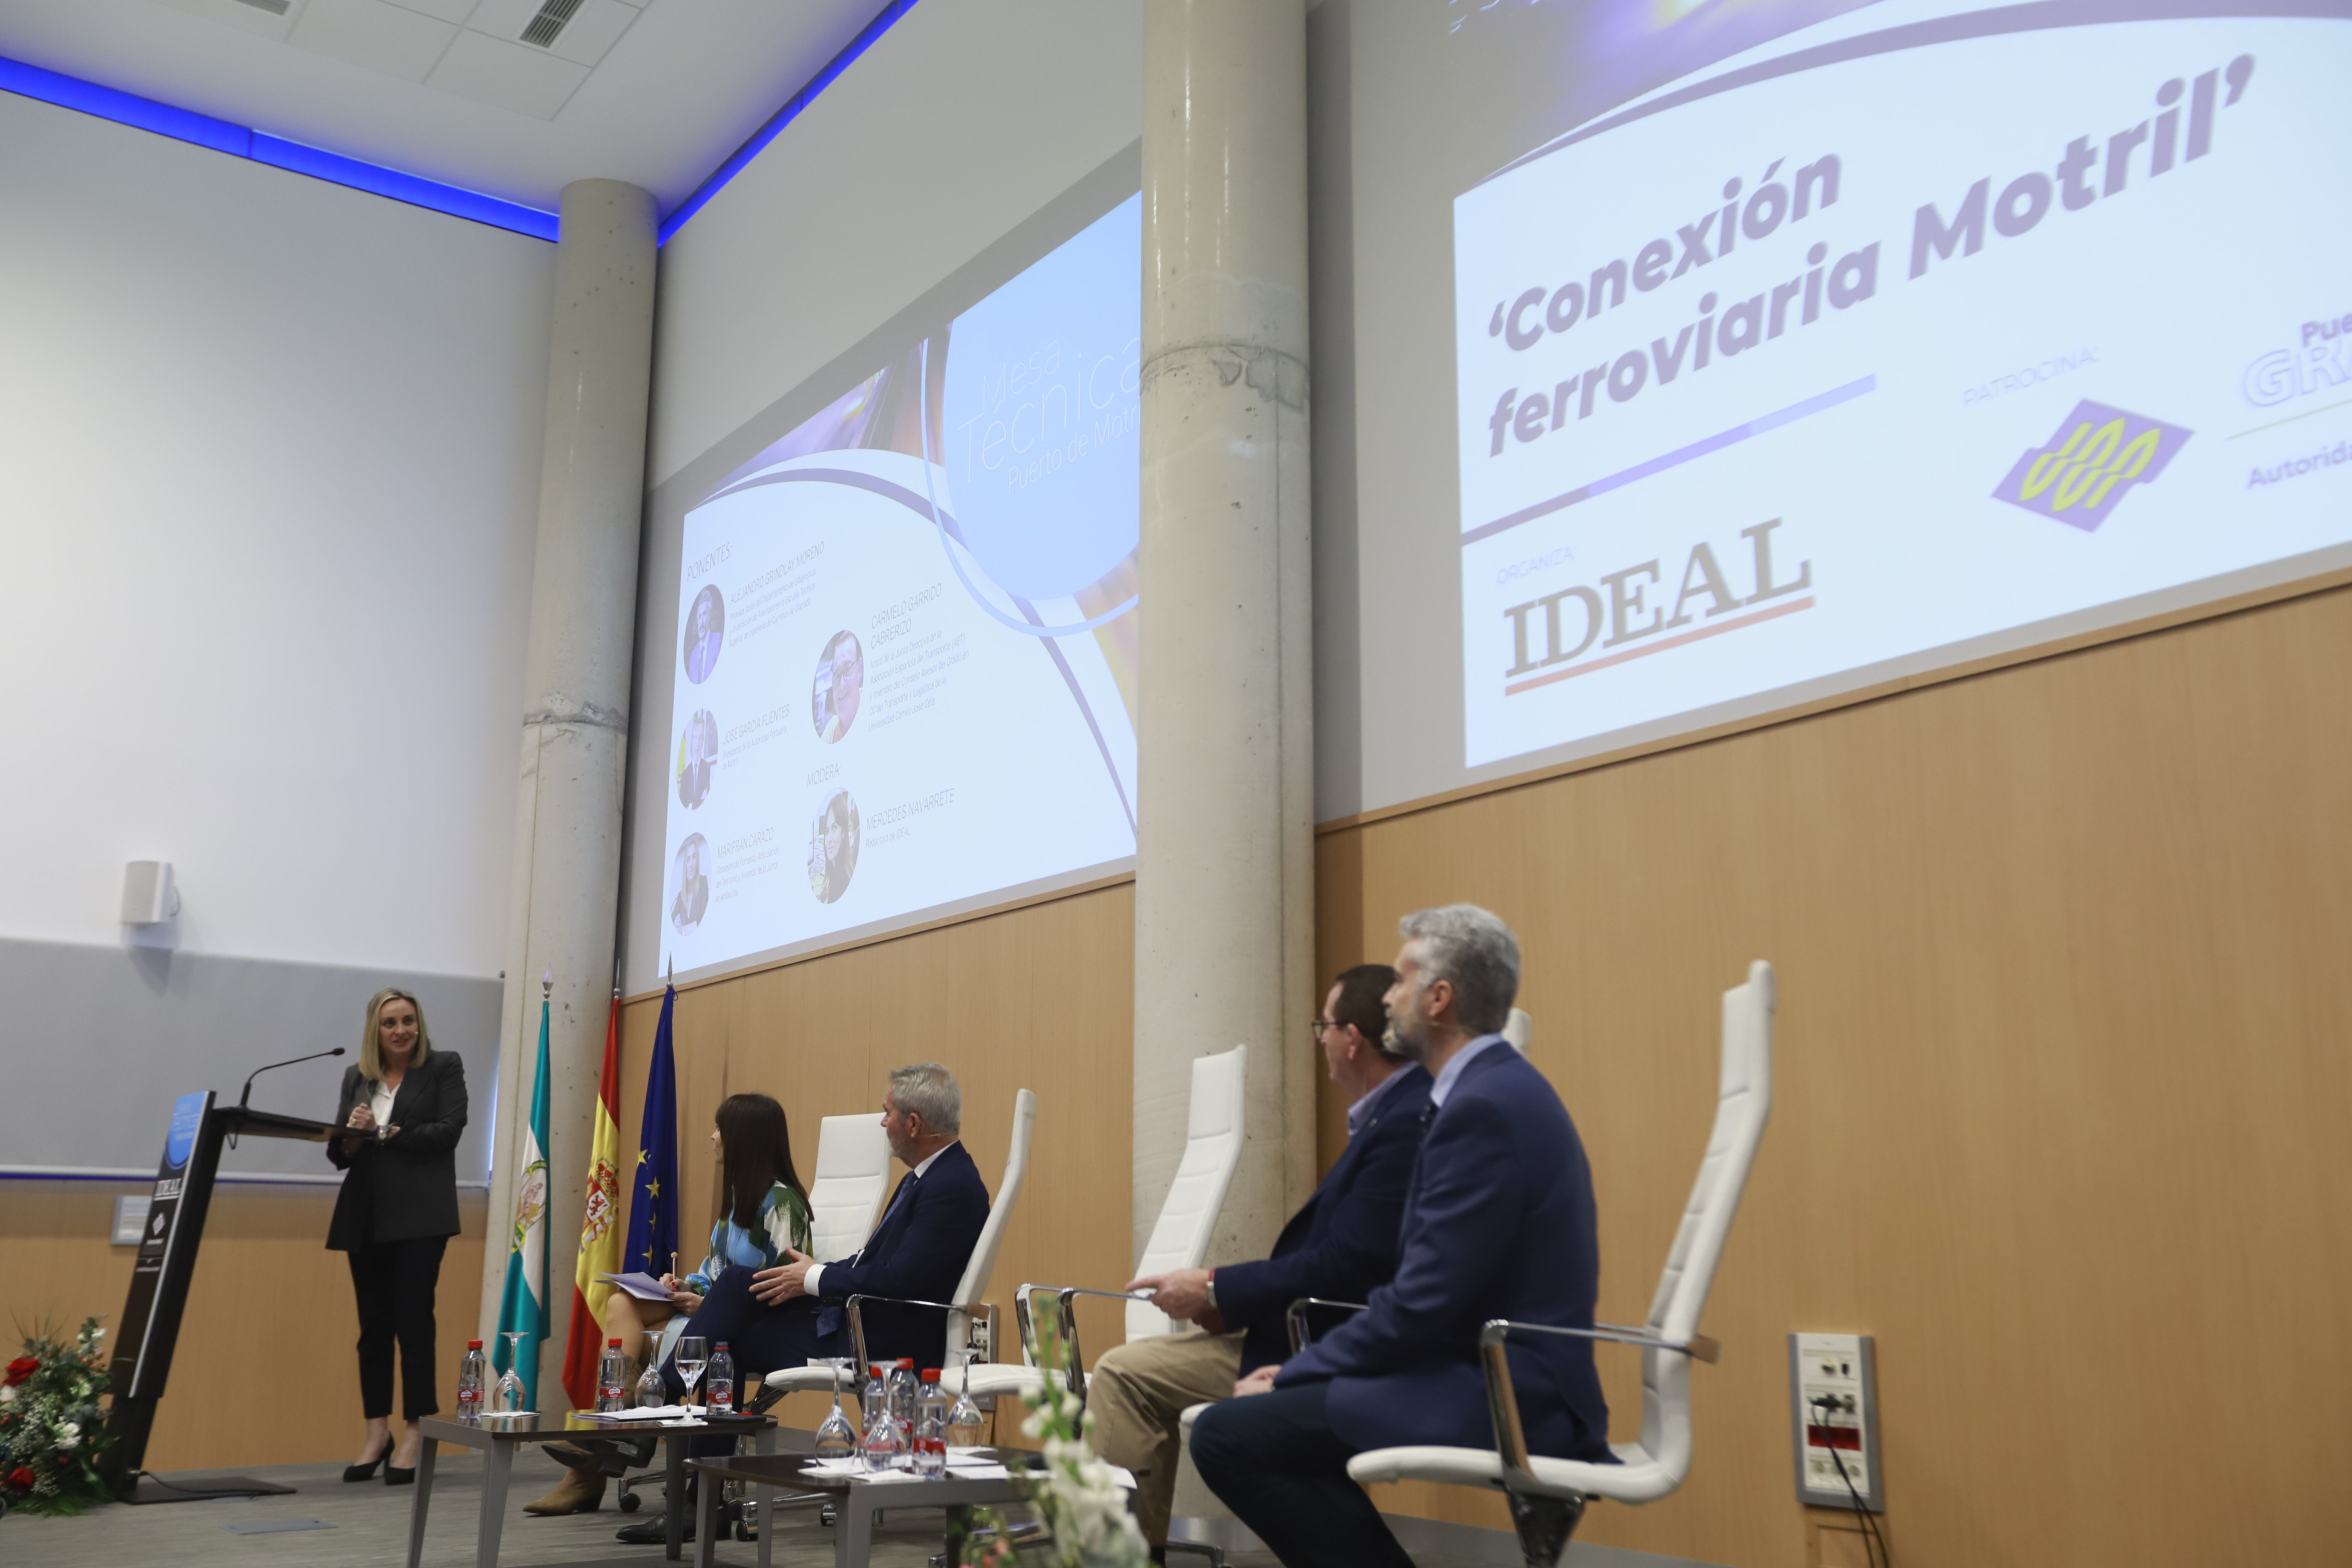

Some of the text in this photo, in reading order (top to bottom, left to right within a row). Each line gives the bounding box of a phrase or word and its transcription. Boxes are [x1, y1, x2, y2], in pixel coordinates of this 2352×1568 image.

[1488, 240, 1882, 458] ferroviaria
[983, 340, 1060, 414] Mesa
[1962, 346, 2099, 408] PATROCINA:
[2243, 337, 2352, 407] GR
[1009, 403, 1140, 495] Puerto de Motri
[2248, 439, 2352, 489] Autorid
[687, 541, 732, 582] PONENTES:
[730, 541, 824, 605] ALEJANDRO GRINDLAY MORENO
[1498, 547, 1576, 583] ORGANIZA:
[730, 608, 744, 621] Profesor
[745, 601, 755, 613] titular
[762, 583, 789, 603] Departamento
[789, 580, 794, 588] de
[732, 616, 752, 632] Ordenación
[758, 604, 775, 618] Territorio
[785, 590, 799, 605] Escuela
[872, 583, 942, 629] CARMELO GARRIDO
[1504, 517, 1811, 678] IDEAL
[729, 634, 743, 648] Superior
[744, 631, 748, 640] de
[767, 618, 772, 627] de
[772, 610, 789, 625] Caminos
[789, 606, 795, 615] de
[795, 597, 811, 612] Granada
[871, 618, 911, 649] CABRERIZO
[870, 667, 894, 684] Asociación
[895, 657, 916, 674] Española
[925, 642, 951, 659] Transporte
[952, 633, 965, 650] (AET)
[871, 629, 941, 669] Vocal de la Junta Directiva de la
[873, 684, 893, 698] miembro
[902, 671, 920, 686] Consejo
[921, 664, 937, 678] Asesor
[947, 652, 962, 666] Grado
[963, 650, 969, 660] en
[868, 712, 894, 731] Universidad
[895, 707, 911, 721] Camilo
[925, 697, 935, 708] Cela
[869, 705, 876, 716] CC
[884, 693, 908, 710] Transporte
[909, 691, 912, 701] y
[913, 681, 934, 697] Logística
[935, 678, 941, 688] de
[942, 675, 946, 684] la
[723, 704, 790, 744] JOSÉ GARCÍA FUENTES
[723, 725, 787, 759] Presidente de la Autoridad Portuaria
[723, 762, 727, 770] de
[807, 763, 841, 787] MODERA:
[867, 787, 954, 830] MERCEDES NAVARRETE
[717, 827, 773, 859] MARIFRÁN CARAZO
[866, 835, 888, 848] Redactora
[889, 831, 895, 841] de
[717, 862, 734, 874] Consejera
[735, 859, 739, 868] de
[740, 854, 757, 867] Fomento,
[722, 875, 738, 886] Territorio
[741, 867, 756, 880] Vivienda
[757, 865, 762, 874] de
[763, 864, 766, 873] la
[767, 862, 778, 871] Junta
[715, 894, 720, 902] de
